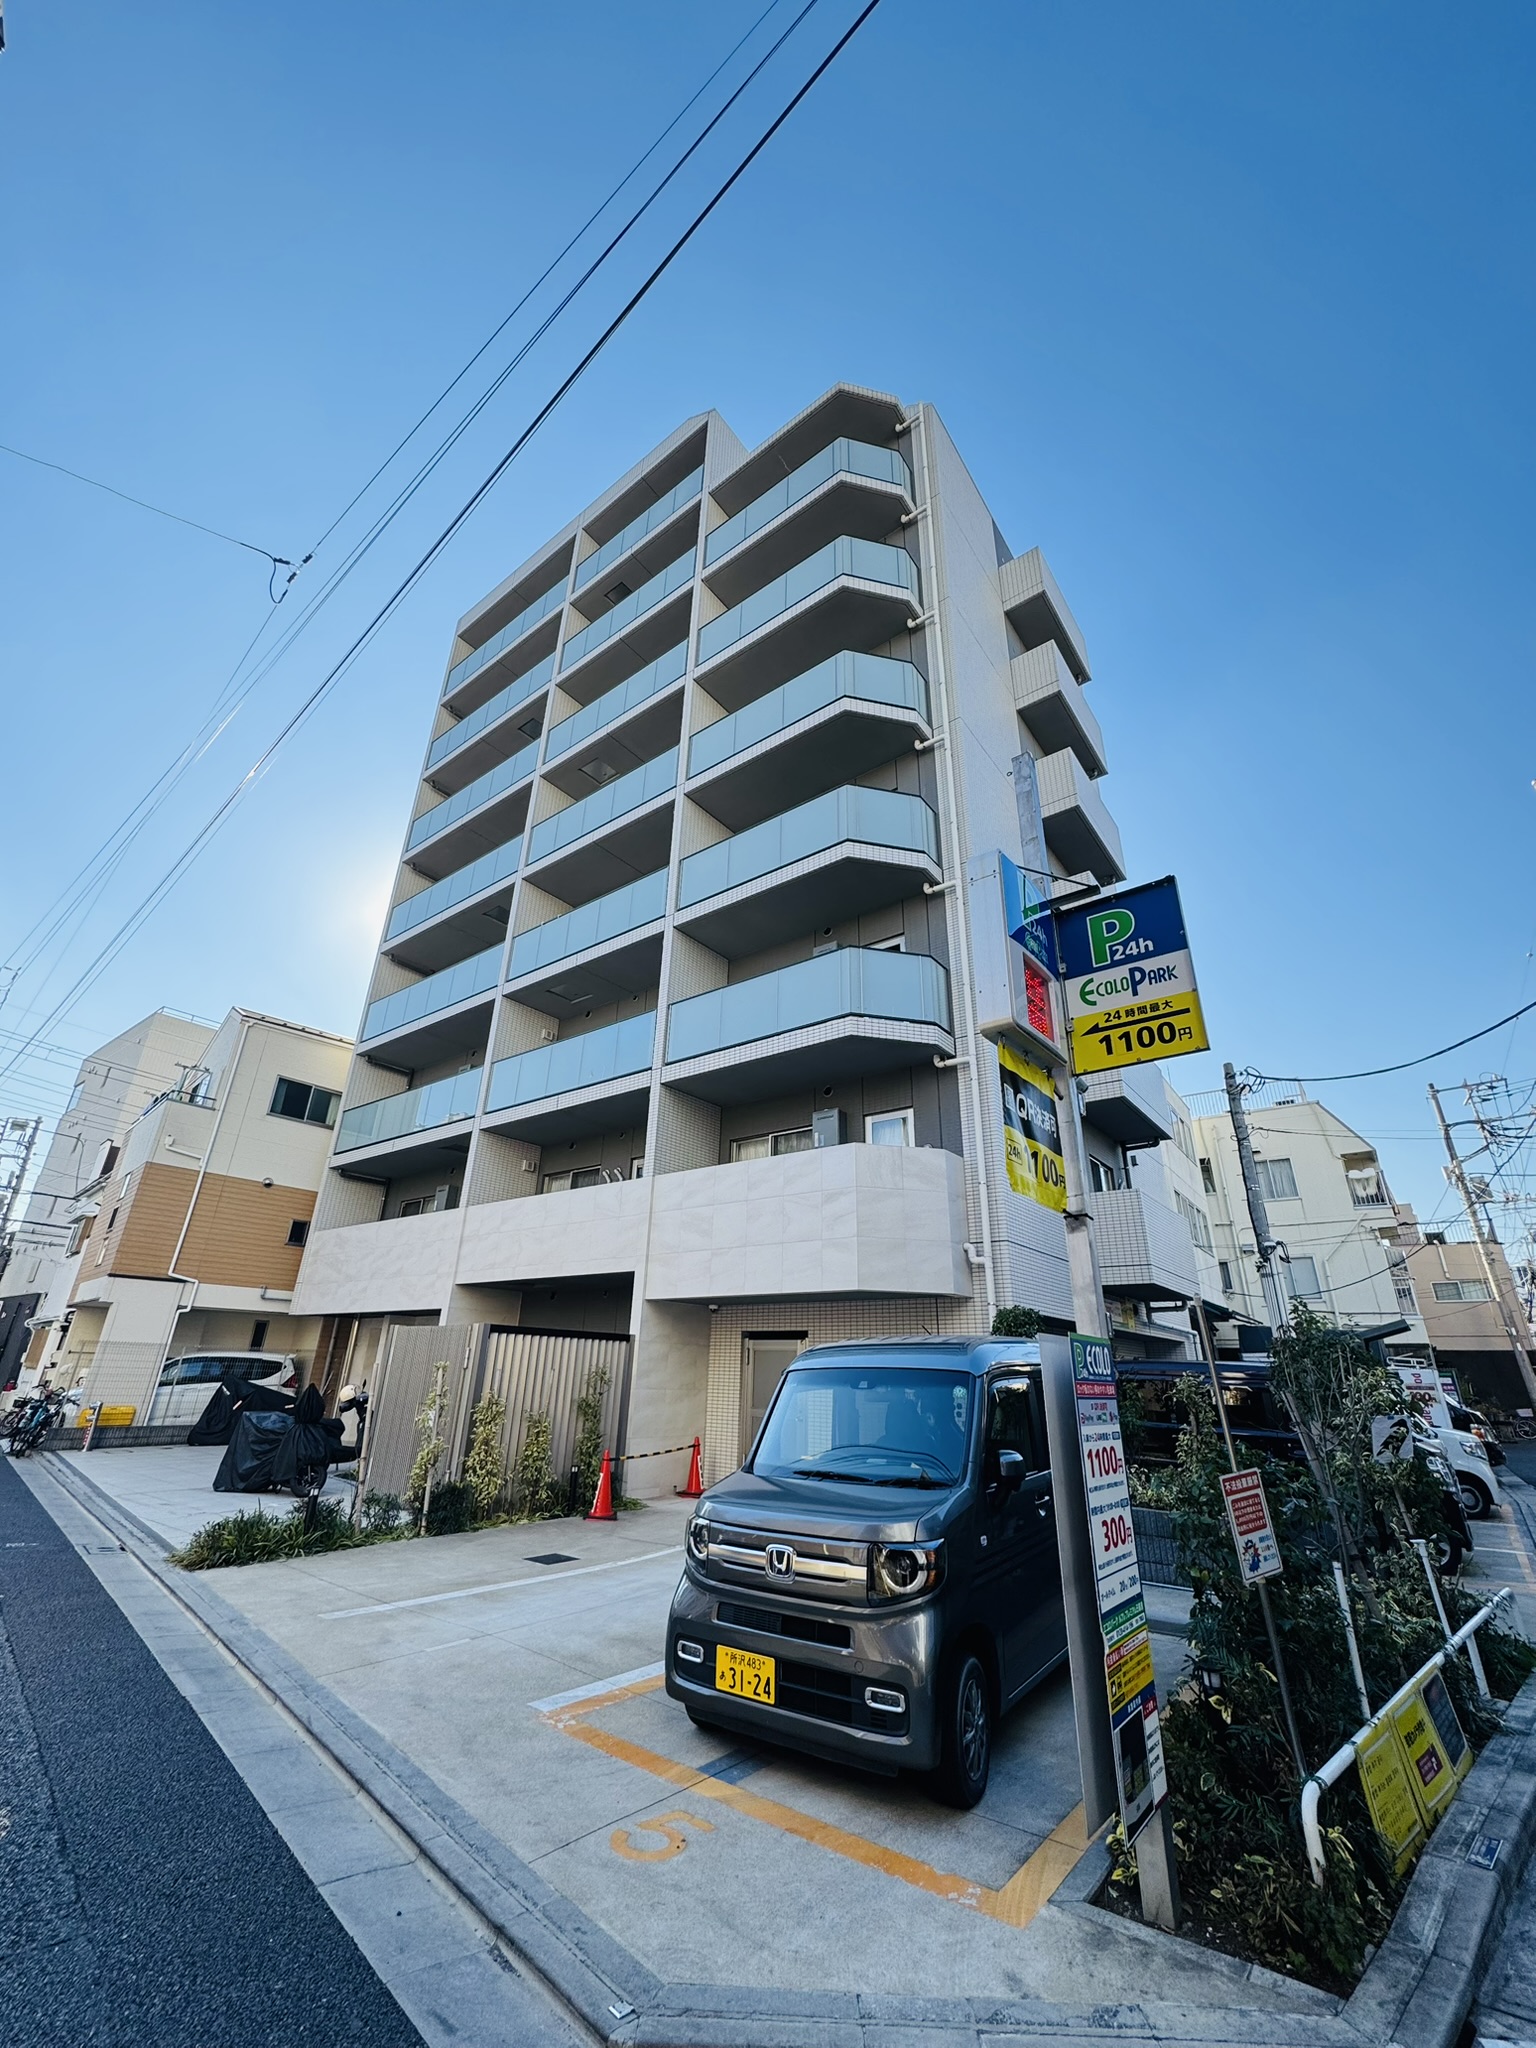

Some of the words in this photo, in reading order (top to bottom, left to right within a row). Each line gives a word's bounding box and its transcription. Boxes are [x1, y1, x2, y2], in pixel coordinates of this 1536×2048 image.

[1086, 908, 1135, 968] P
[1112, 937, 1154, 961] 24h
[1103, 999, 1174, 1024] 24時間最大
[1098, 1021, 1193, 1056] 1100円
[1007, 1143, 1021, 1159] 24h
[1085, 1344, 1112, 1376] ECOLO
[1086, 1445, 1125, 1479] 1100円
[1101, 1514, 1133, 1553] 300円
[728, 1666, 771, 1700] 31-24
[609, 1809, 718, 1863] 5
